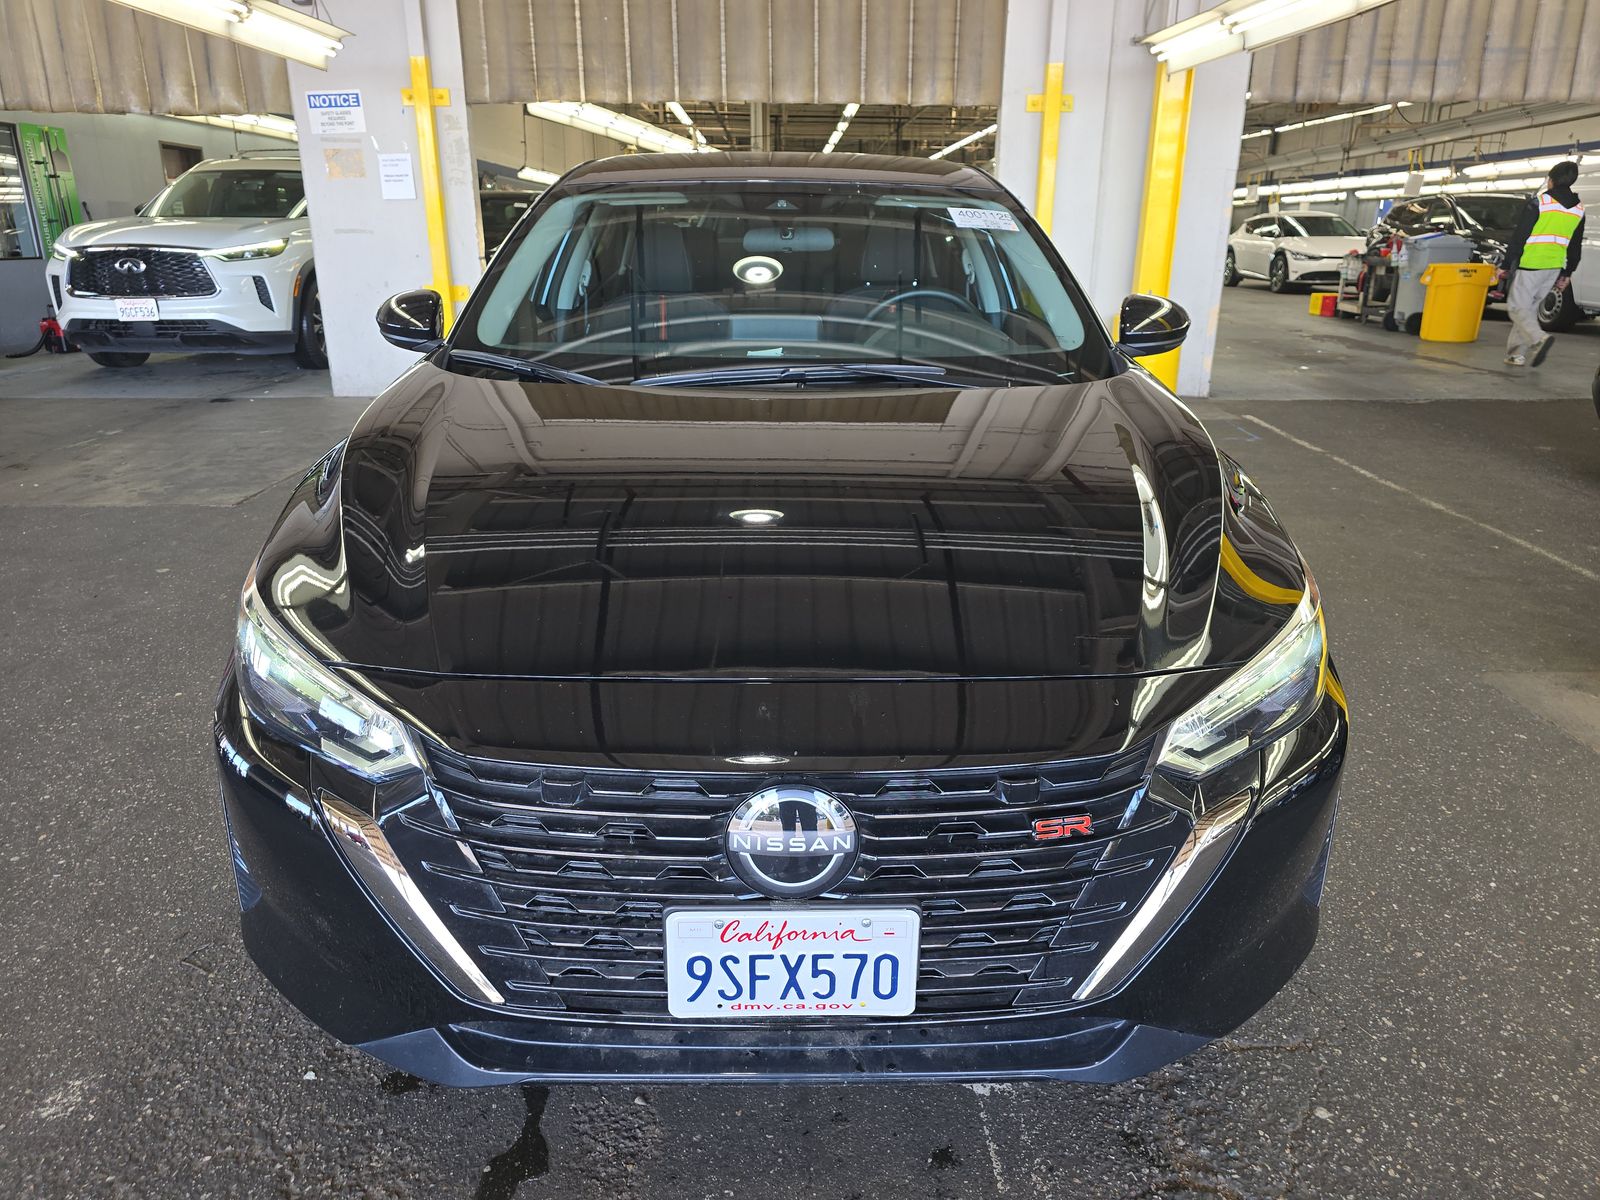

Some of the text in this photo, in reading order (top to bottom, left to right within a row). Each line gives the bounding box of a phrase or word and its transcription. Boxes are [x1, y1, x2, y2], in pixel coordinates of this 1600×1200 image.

[309, 94, 358, 107] NOTICE
[1034, 815, 1093, 840] SR
[733, 834, 851, 852] NISSAN
[720, 919, 873, 950] California
[686, 953, 899, 1002] 9SFX570
[731, 1003, 854, 1011] dmv.ca.gov
